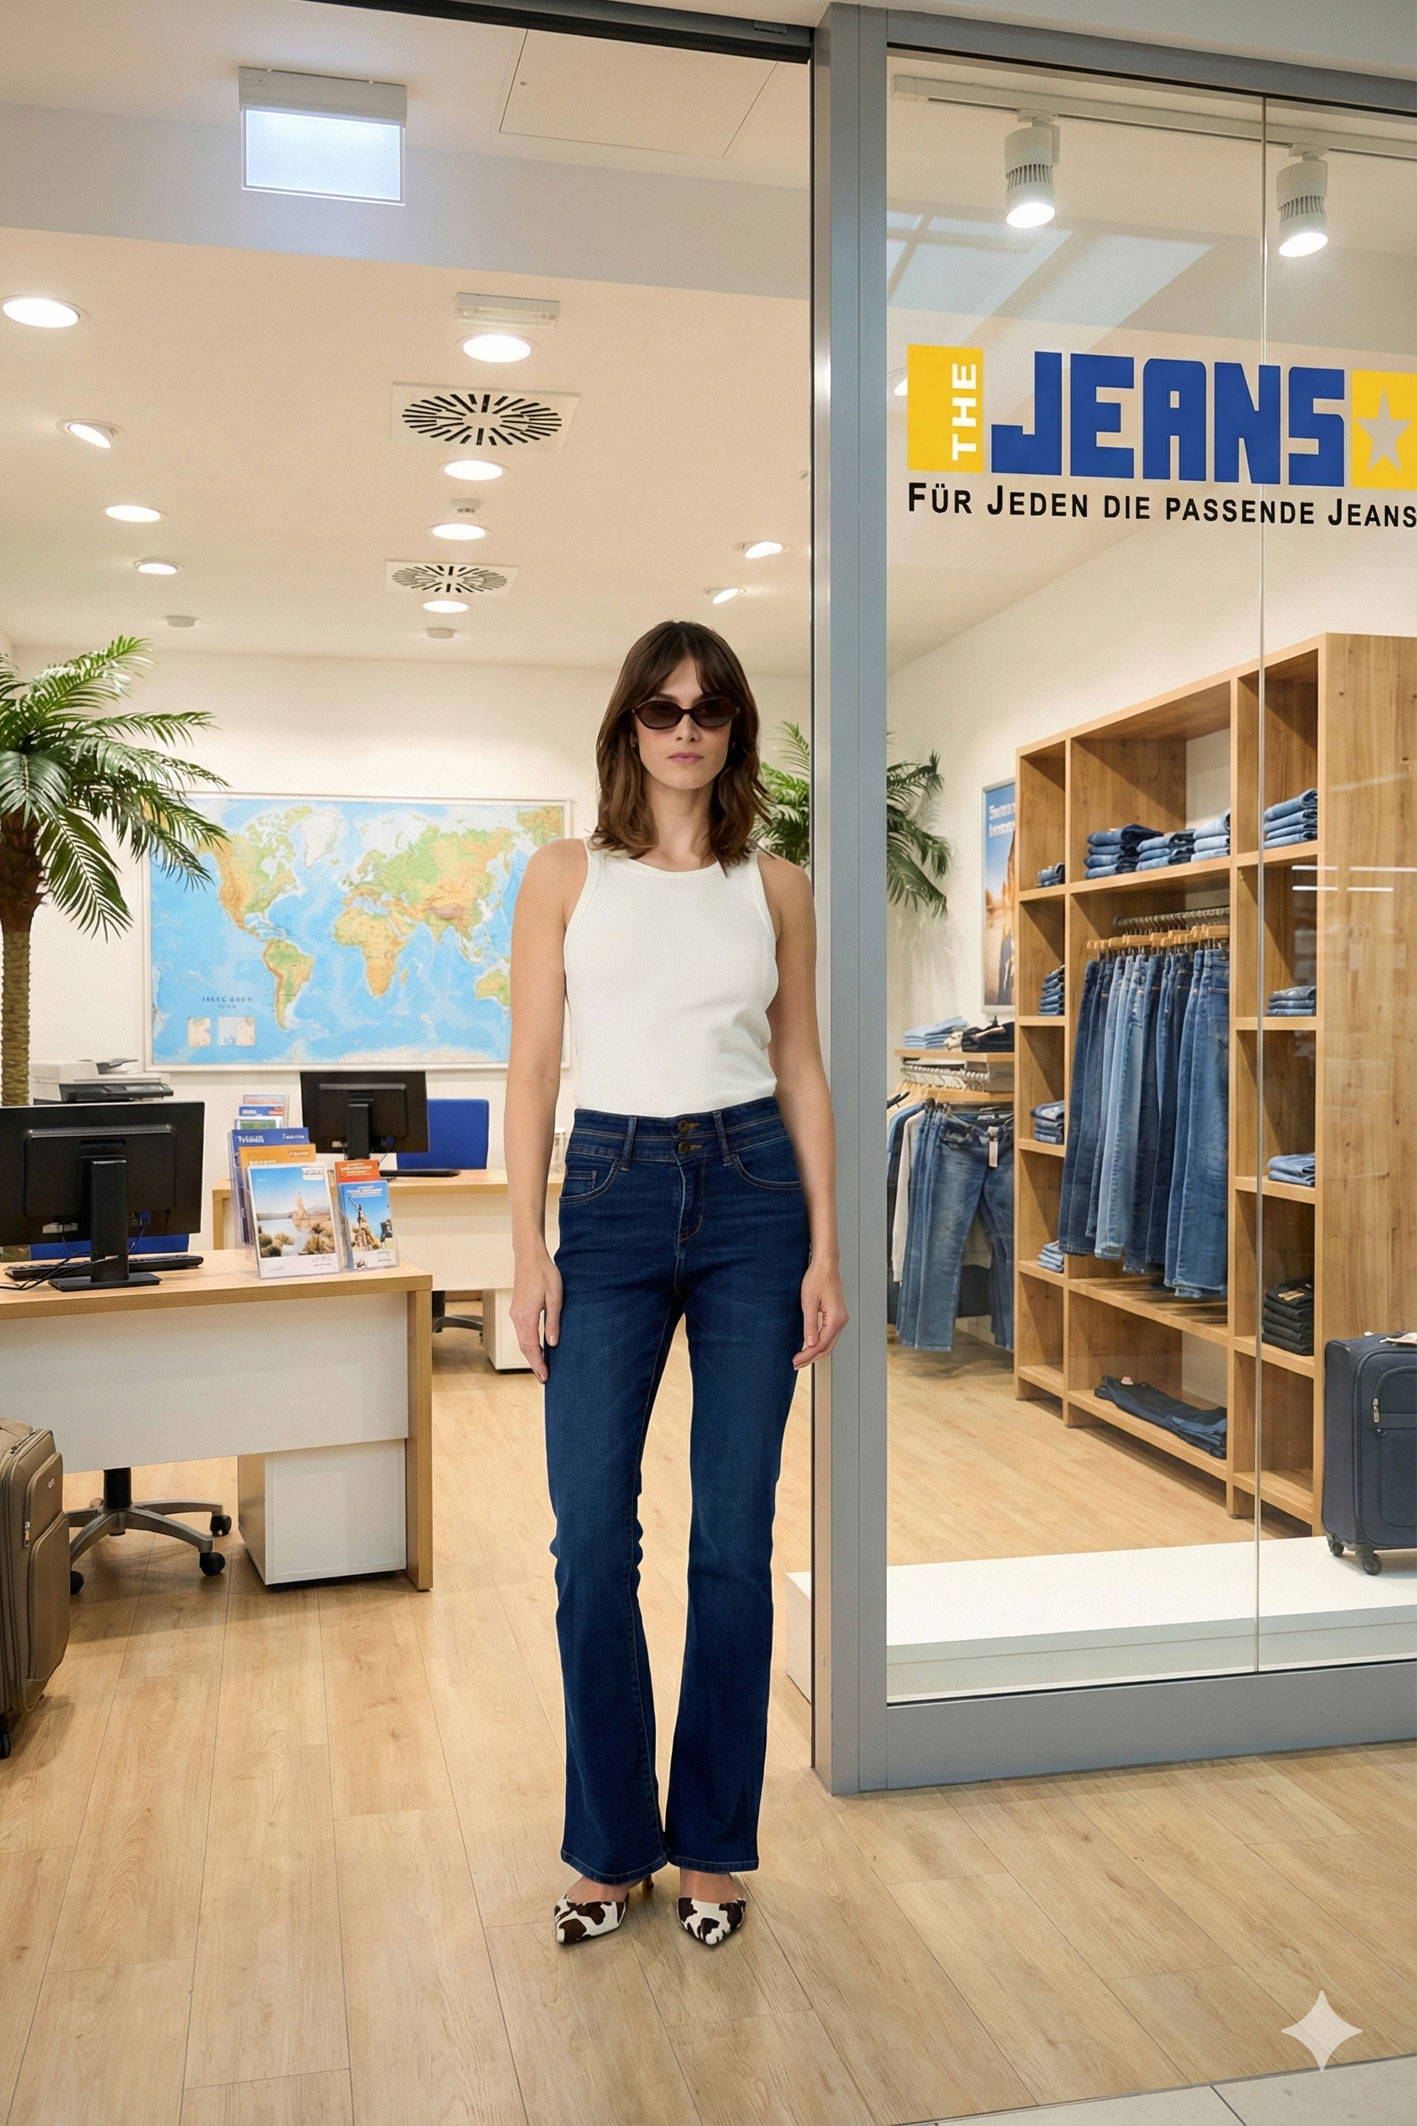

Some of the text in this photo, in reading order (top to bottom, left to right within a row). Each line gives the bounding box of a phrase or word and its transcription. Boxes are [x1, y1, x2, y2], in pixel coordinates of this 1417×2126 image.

[951, 351, 1345, 487] THE JEANS
[908, 482, 1417, 528] FÜR JEDEN DIE PASSENDE JEANS
